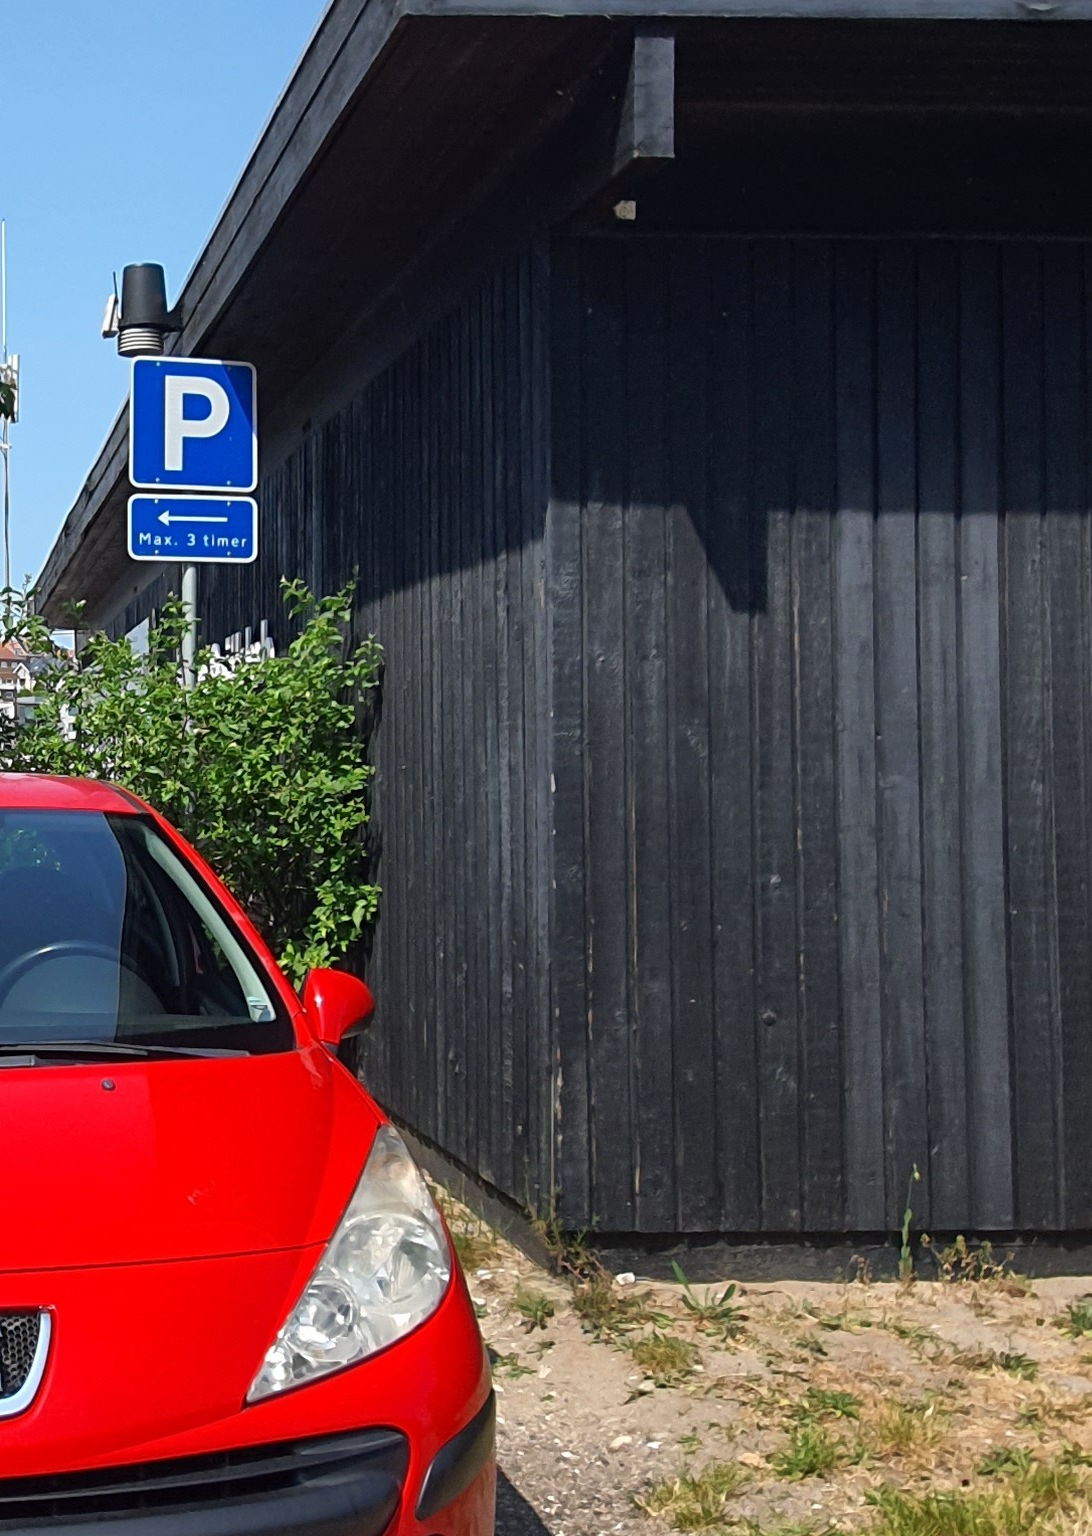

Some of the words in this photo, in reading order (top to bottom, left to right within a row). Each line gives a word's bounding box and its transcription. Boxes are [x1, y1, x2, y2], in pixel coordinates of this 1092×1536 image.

[164, 374, 230, 471] P
[139, 532, 179, 546] Max.
[187, 533, 196, 547] 3
[203, 534, 247, 548] timer
